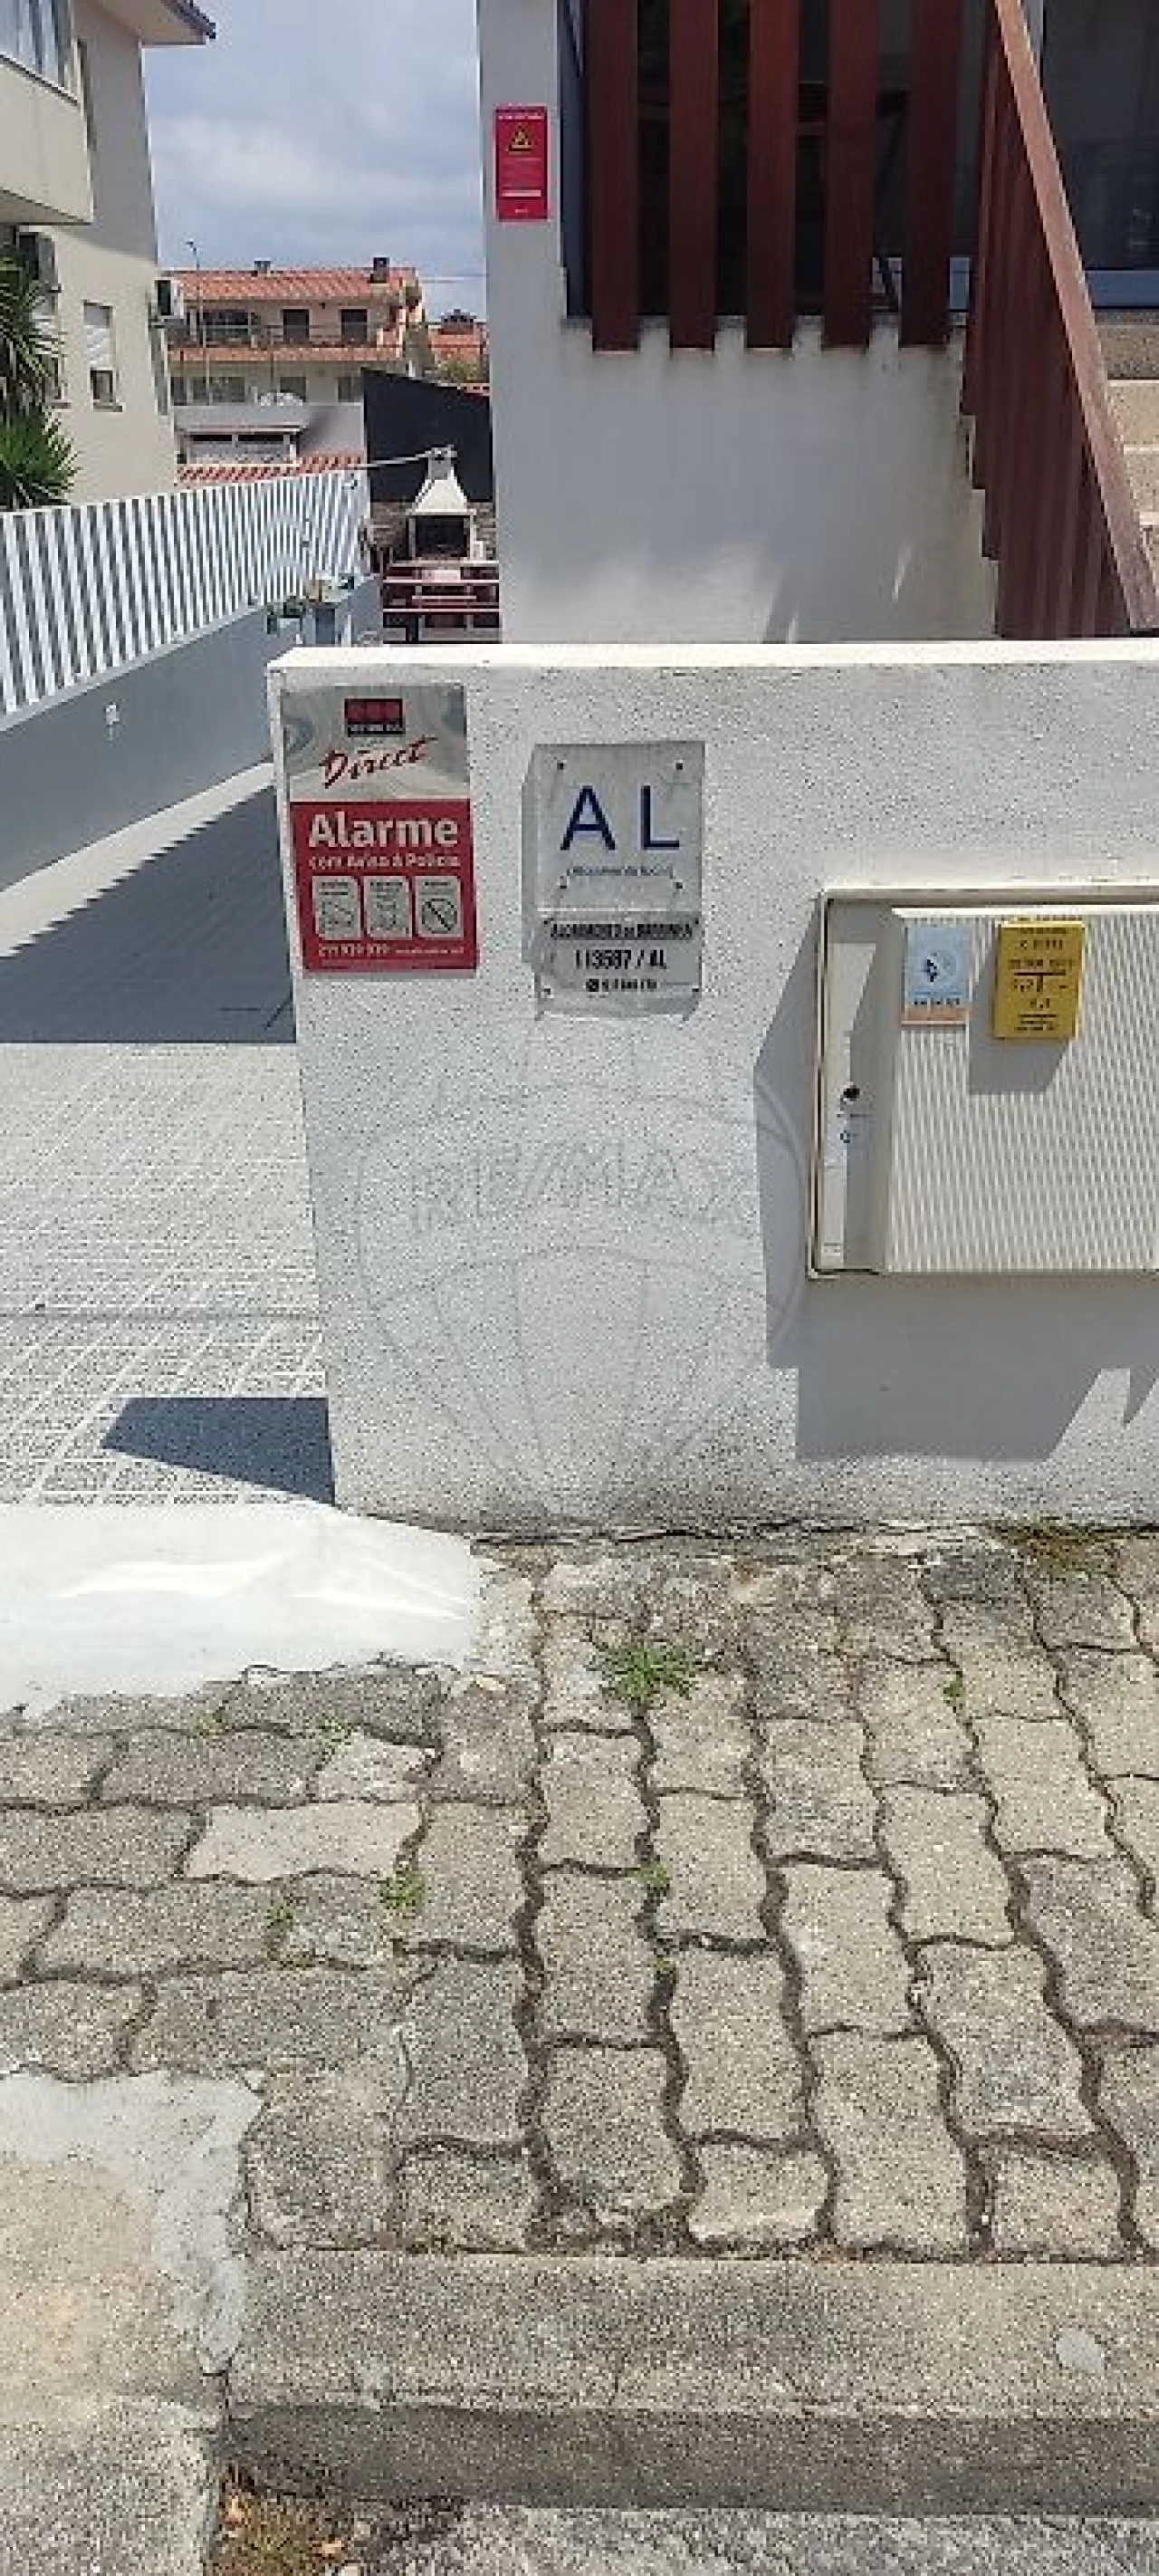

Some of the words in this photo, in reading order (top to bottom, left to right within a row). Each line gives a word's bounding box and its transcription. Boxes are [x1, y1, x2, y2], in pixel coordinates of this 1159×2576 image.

[319, 734, 438, 788] Direct
[308, 811, 459, 848] Alarme
[648, 949, 668, 970] AL
